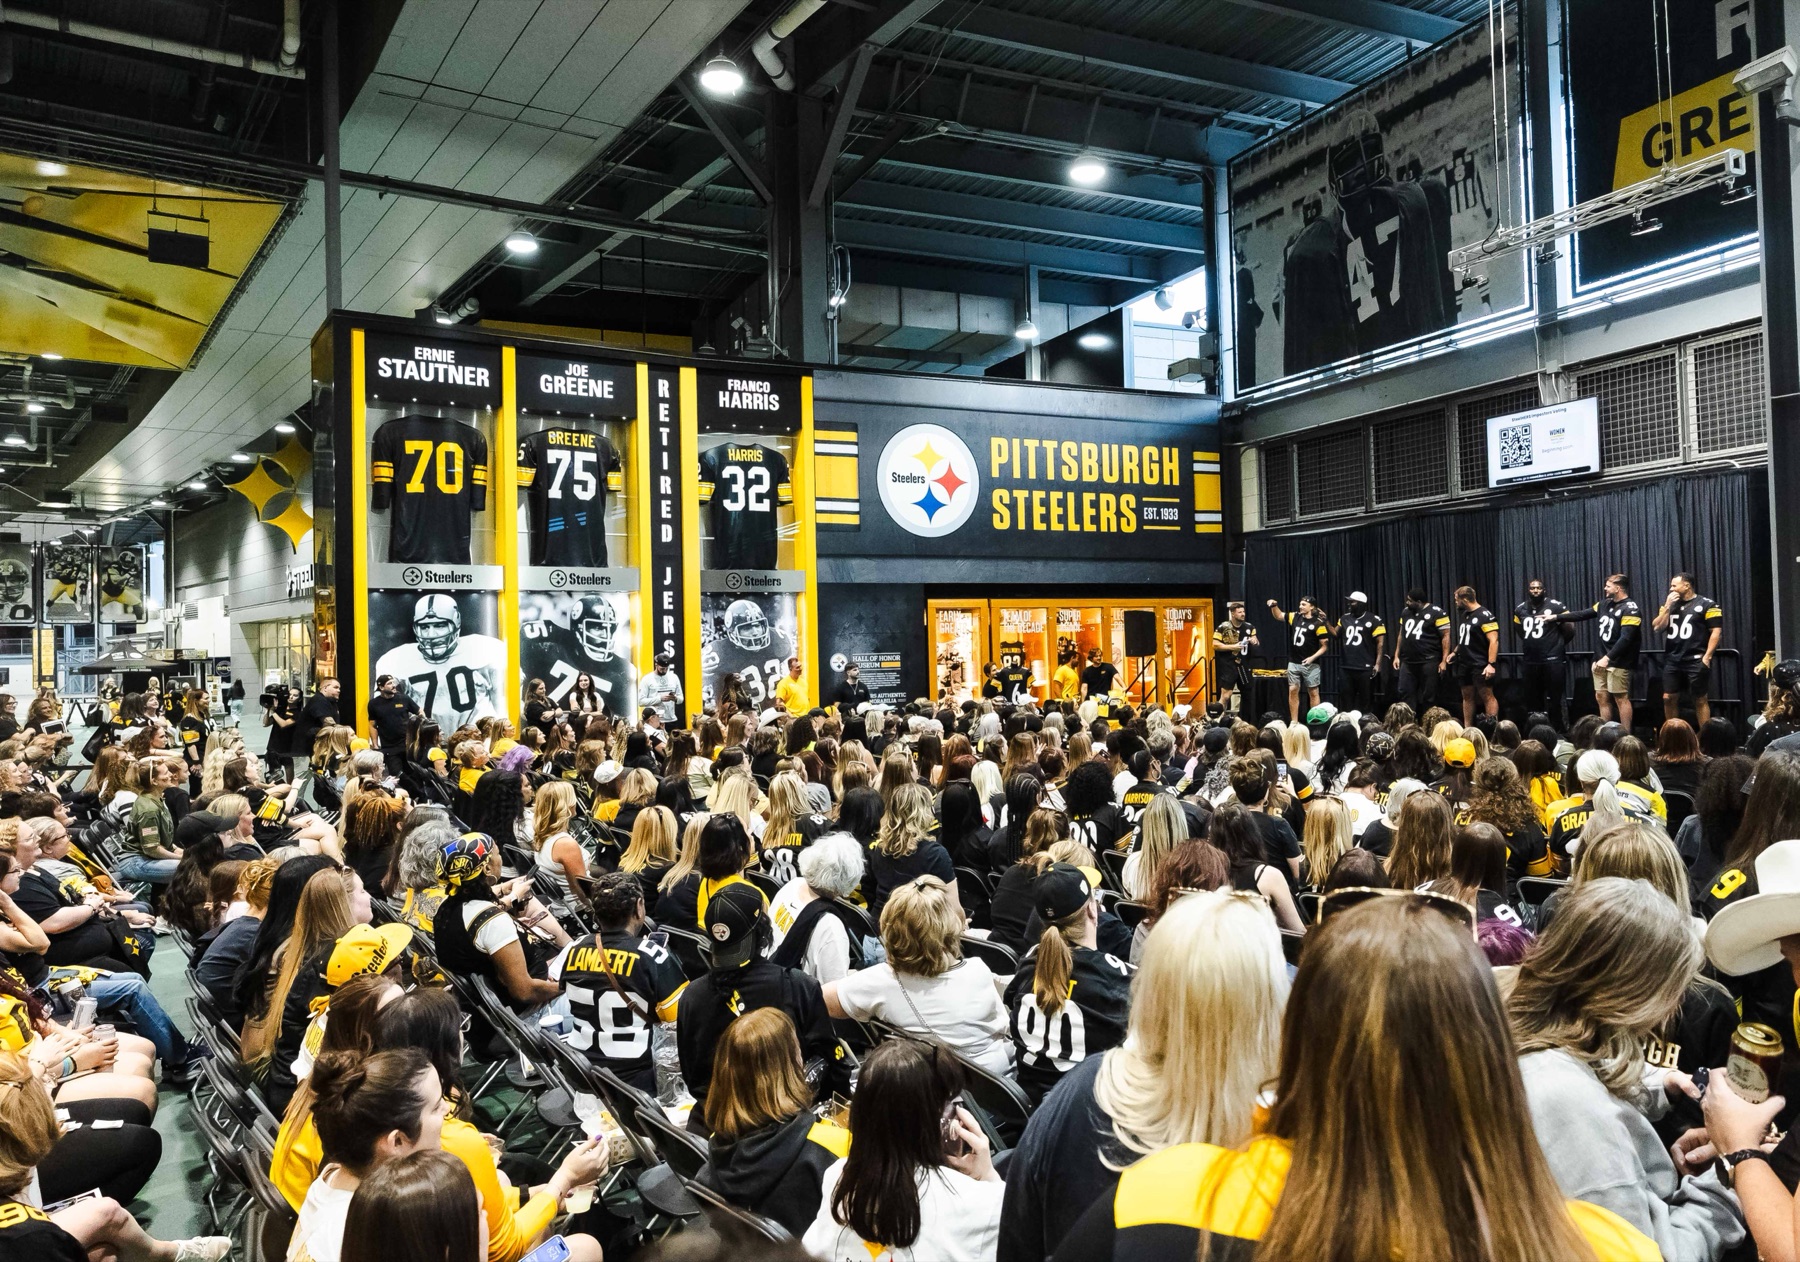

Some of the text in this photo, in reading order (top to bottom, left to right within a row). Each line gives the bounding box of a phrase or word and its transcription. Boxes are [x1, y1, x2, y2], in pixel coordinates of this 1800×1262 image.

[1642, 92, 1751, 168] GRE
[414, 346, 455, 363] ERNIE
[378, 357, 490, 388] STAUTNER
[565, 363, 589, 377] JOE
[540, 374, 614, 399] GREENE
[727, 379, 771, 393] FRANCO
[718, 391, 780, 411] HARRIS
[547, 430, 596, 449] GREENE
[404, 440, 464, 494] 70
[658, 379, 674, 543] RETIRED
[728, 448, 763, 462] HARRIS
[990, 437, 1180, 485] PITTSBURGH
[546, 449, 597, 501] 75
[892, 472, 925, 484] Steelers
[722, 465, 770, 512] 32
[992, 488, 1179, 533] STEELERS EST. 1933
[425, 570, 473, 584] Steelers
[569, 572, 612, 586] Steelers
[744, 575, 782, 587] Steelers
[1293, 626, 1307, 647] 15
[1345, 626, 1363, 646] 95
[1404, 619, 1425, 640] 94
[1459, 623, 1471, 645] 91
[1523, 616, 1544, 639] 93
[1667, 614, 1693, 639] 56
[408, 665, 477, 719] 70
[1012, 683, 1021, 706] 6
[1711, 869, 1746, 899] 9
[774, 902, 796, 935] WAT
[565, 982, 650, 1058] 58
[1017, 993, 1086, 1072] 90
[1647, 1039, 1681, 1069] GH
